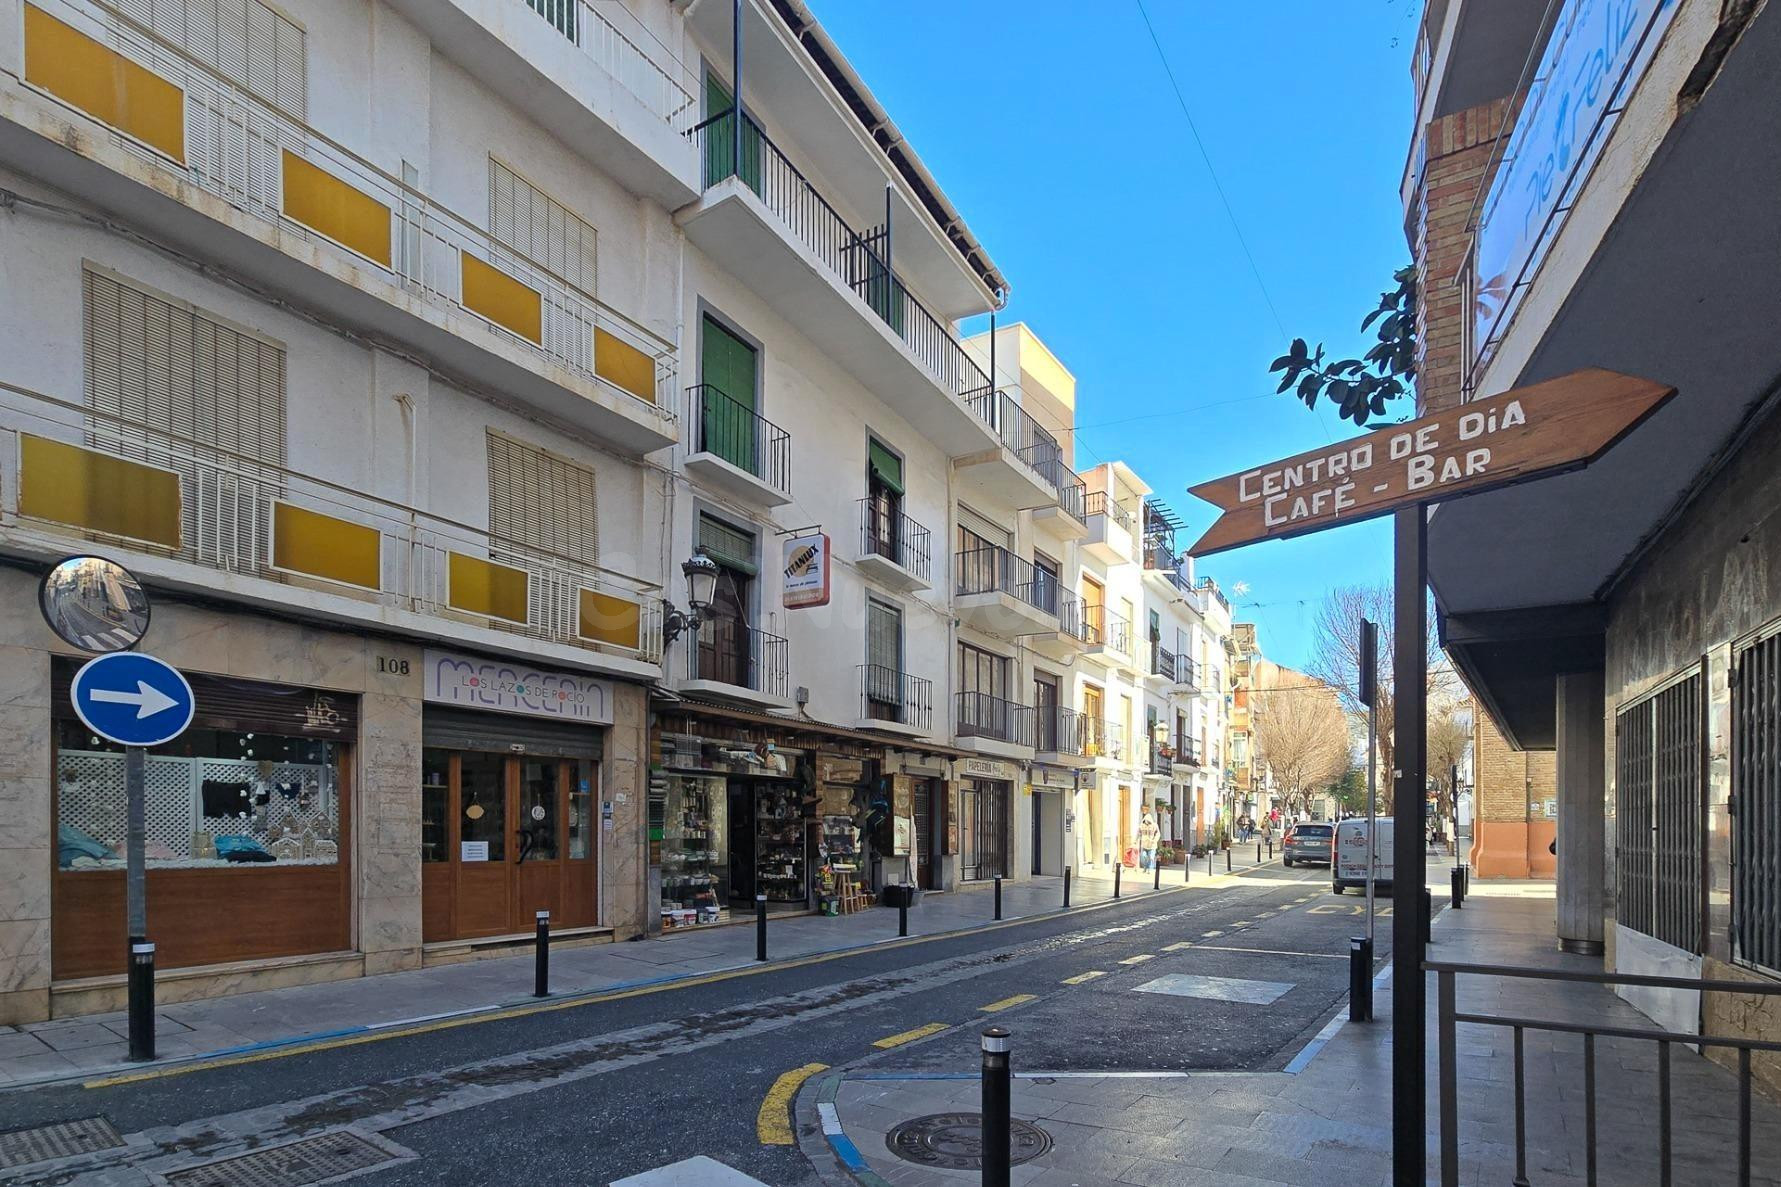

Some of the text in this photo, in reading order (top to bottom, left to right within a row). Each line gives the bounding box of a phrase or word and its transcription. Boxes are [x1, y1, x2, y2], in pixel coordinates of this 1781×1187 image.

[1239, 443, 1373, 504] CENTRO
[1389, 423, 1440, 461] DE
[1264, 475, 1356, 528] CAFÉ
[1406, 447, 1492, 492] BAR
[783, 543, 820, 579] TITANLUX
[378, 656, 410, 675] 108
[462, 675, 488, 689] LOS
[490, 682, 532, 697] LAZOS
[535, 686, 549, 698] DE
